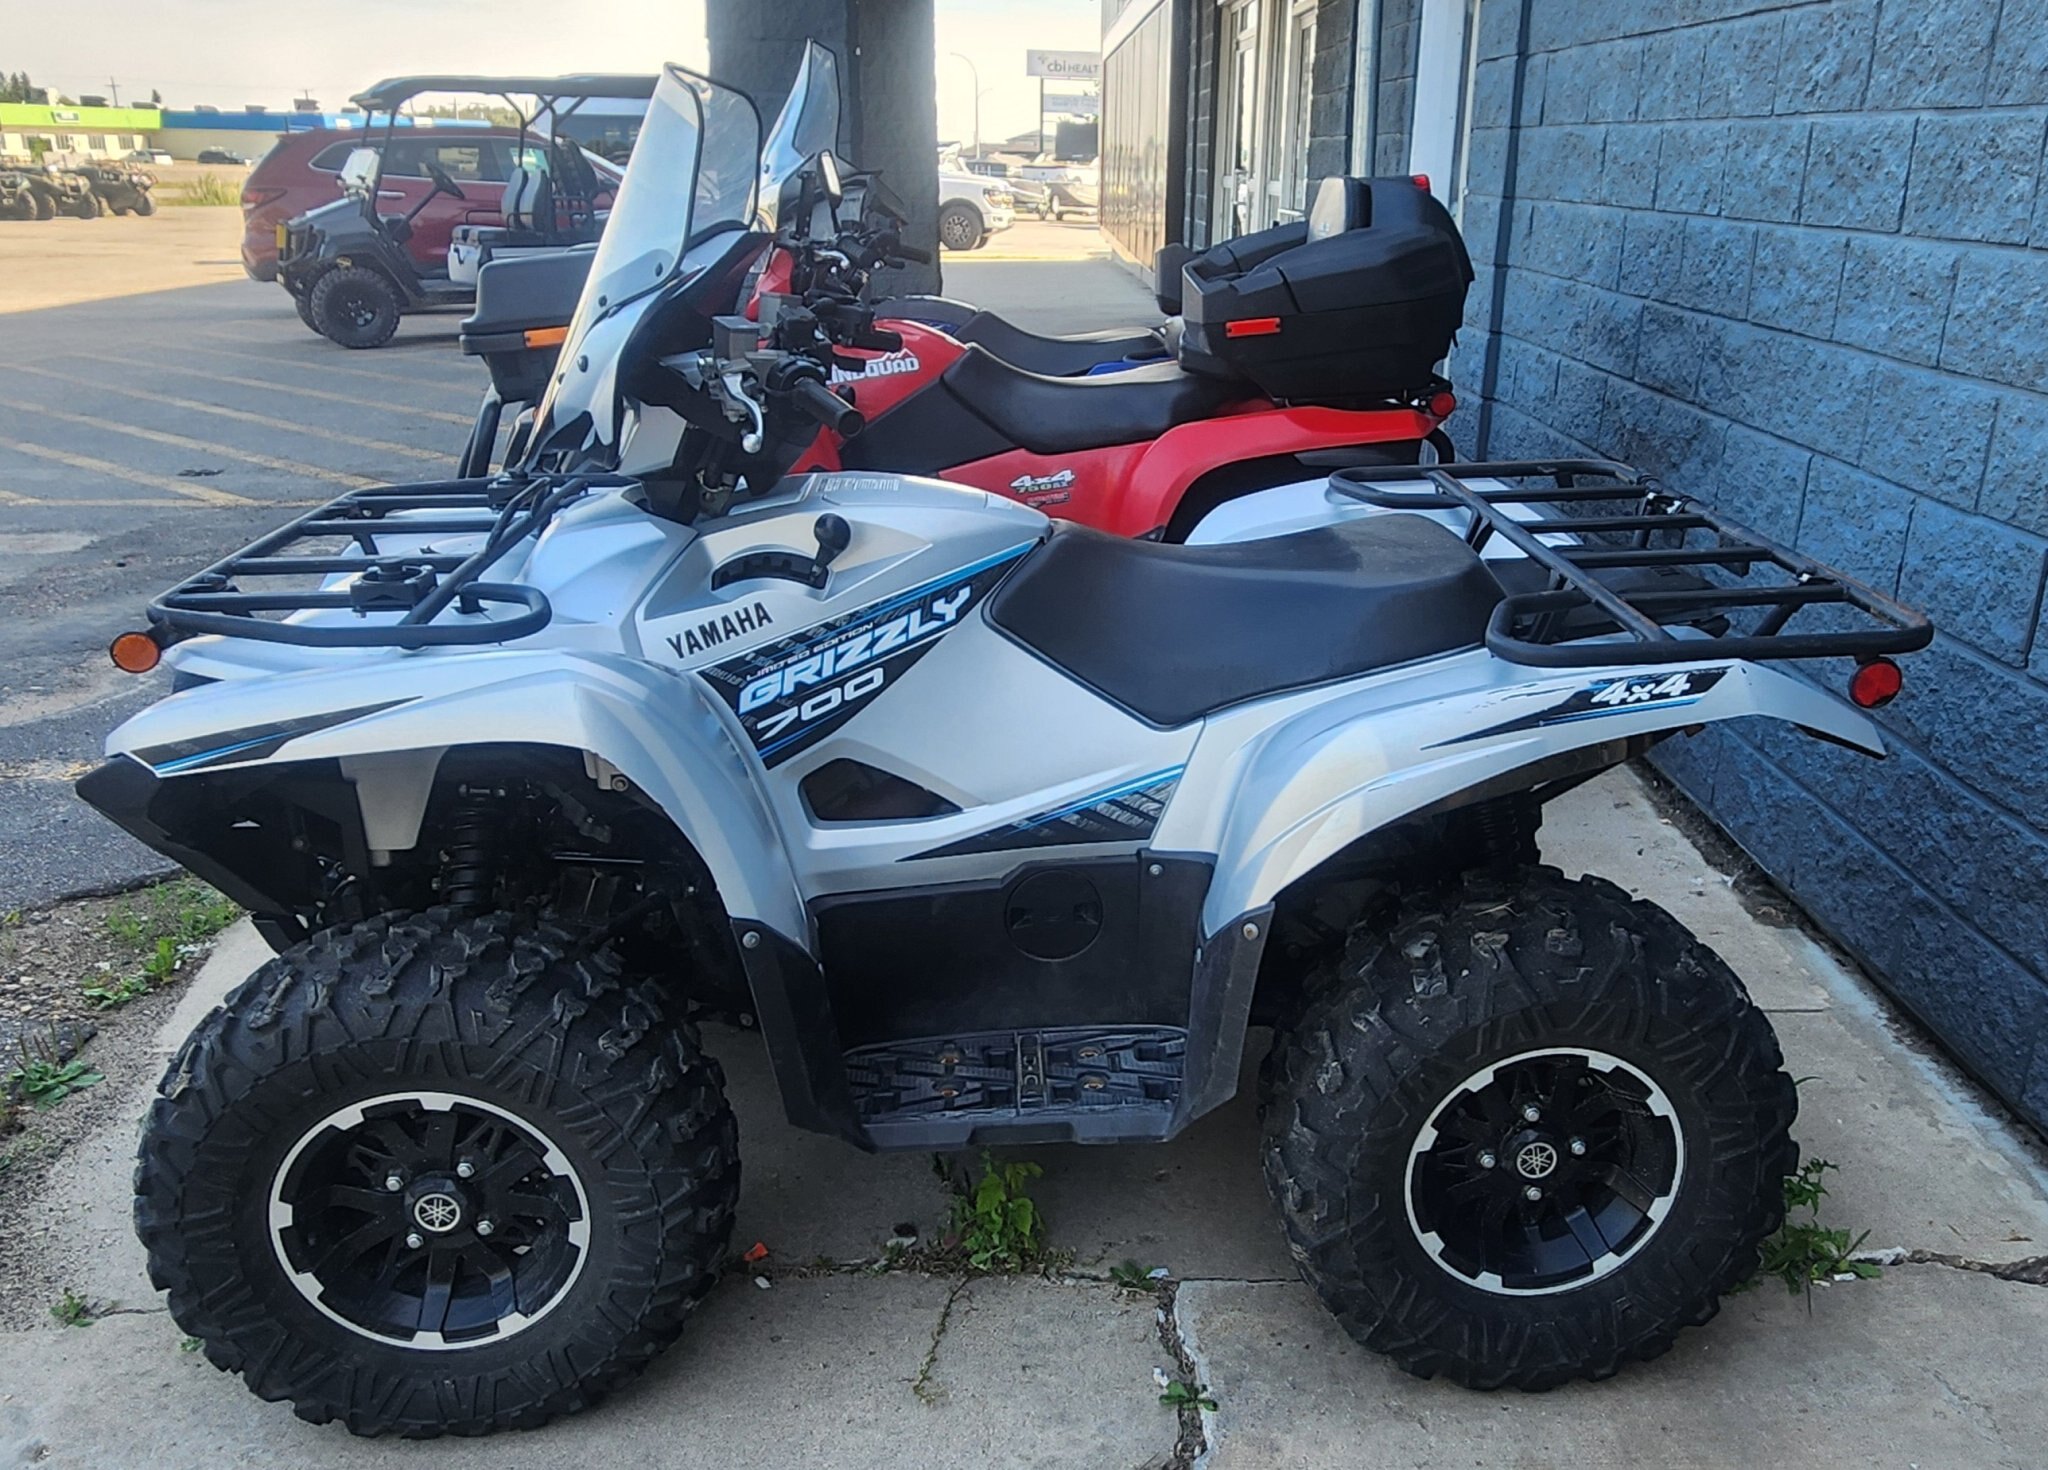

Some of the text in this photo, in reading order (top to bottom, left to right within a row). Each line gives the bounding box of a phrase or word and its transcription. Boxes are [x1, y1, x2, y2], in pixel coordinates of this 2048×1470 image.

[1047, 60, 1100, 74] cbi HEALT
[1010, 469, 1075, 487] 4x4
[666, 602, 773, 659] YAMAHA
[738, 584, 971, 715] GRIZZLY
[746, 622, 874, 681] LIMITED EDITION
[757, 667, 884, 742] 700
[1591, 673, 1691, 705] 4x4
